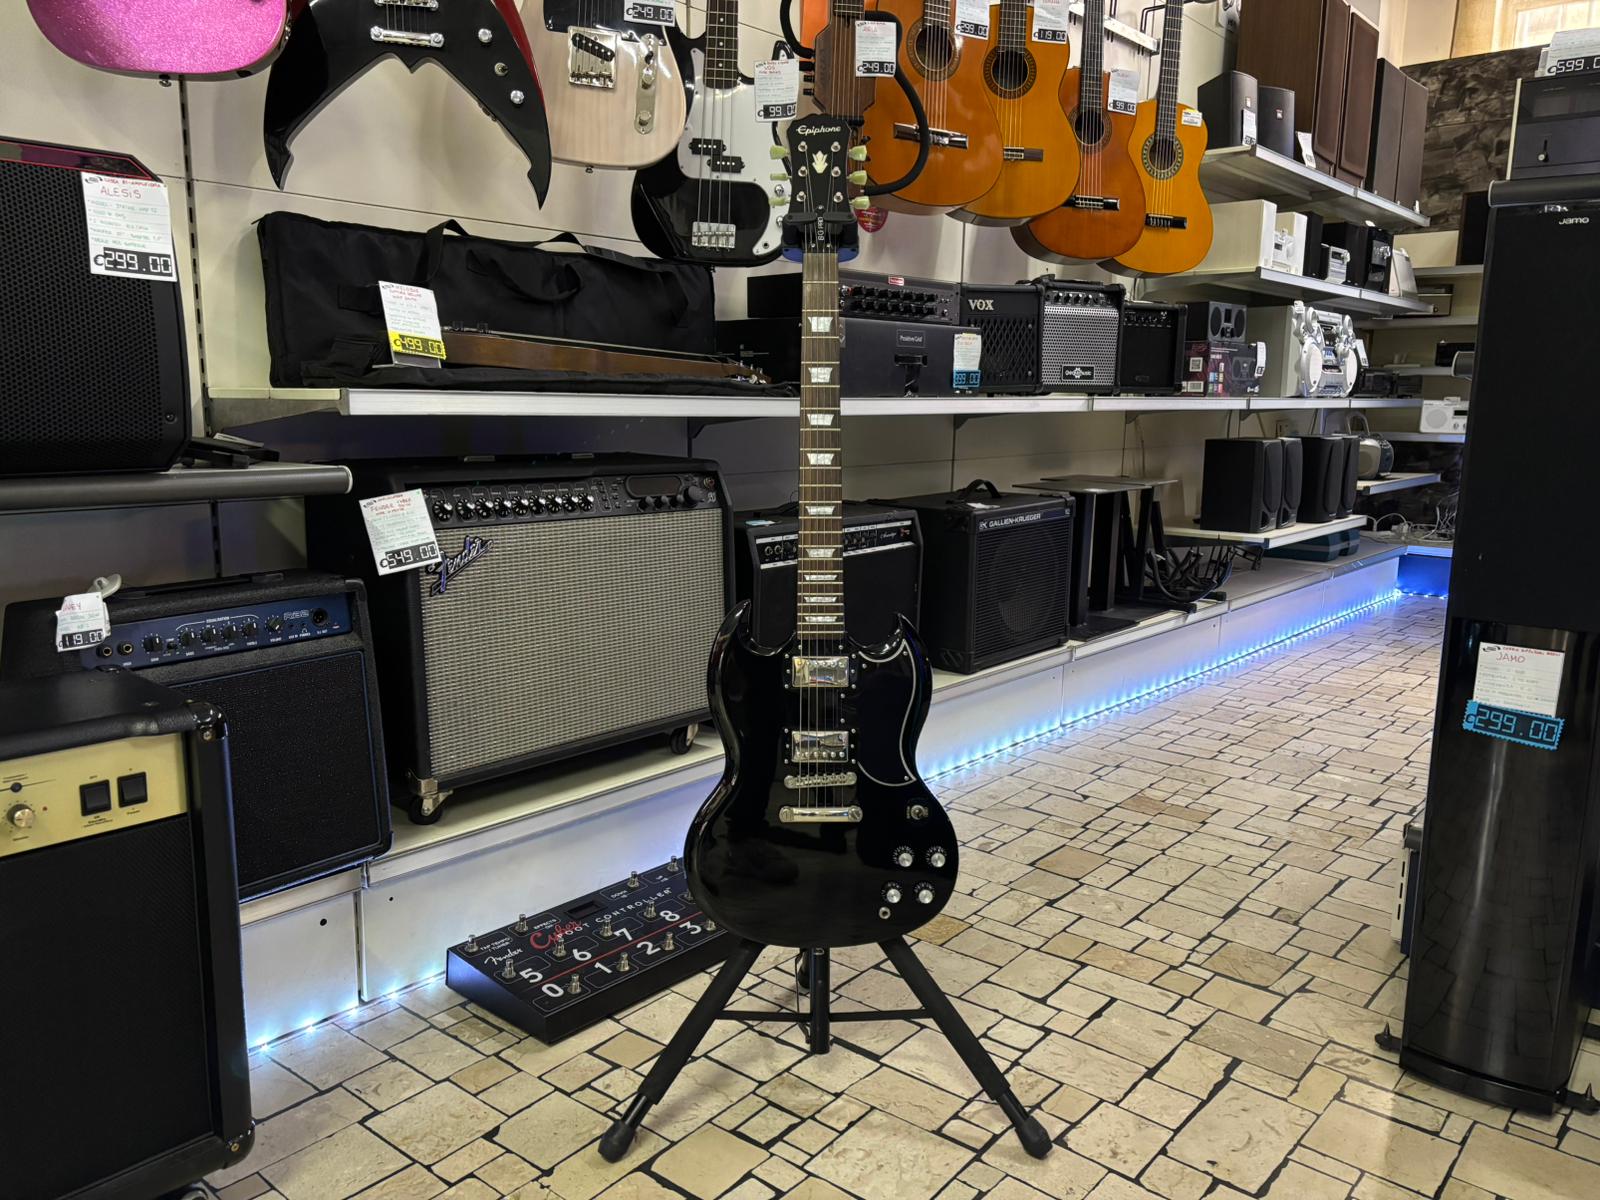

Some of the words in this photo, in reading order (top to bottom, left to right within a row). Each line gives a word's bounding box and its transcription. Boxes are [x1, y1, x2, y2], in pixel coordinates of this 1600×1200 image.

[796, 125, 841, 136] Epiphone
[967, 299, 995, 311] VOX
[988, 513, 1041, 528] GALLIEN-KRUEGER
[425, 535, 494, 597] Fender
[595, 887, 671, 923] CONTROLLER
[484, 948, 523, 966] Fender
[520, 968, 543, 983] 5
[572, 949, 592, 961] 6
[614, 928, 633, 941] 7
[660, 910, 680, 922] 8
[541, 983, 564, 997] 0
[594, 961, 612, 974] 1
[636, 941, 661, 955] 2
[679, 921, 702, 935] 3
